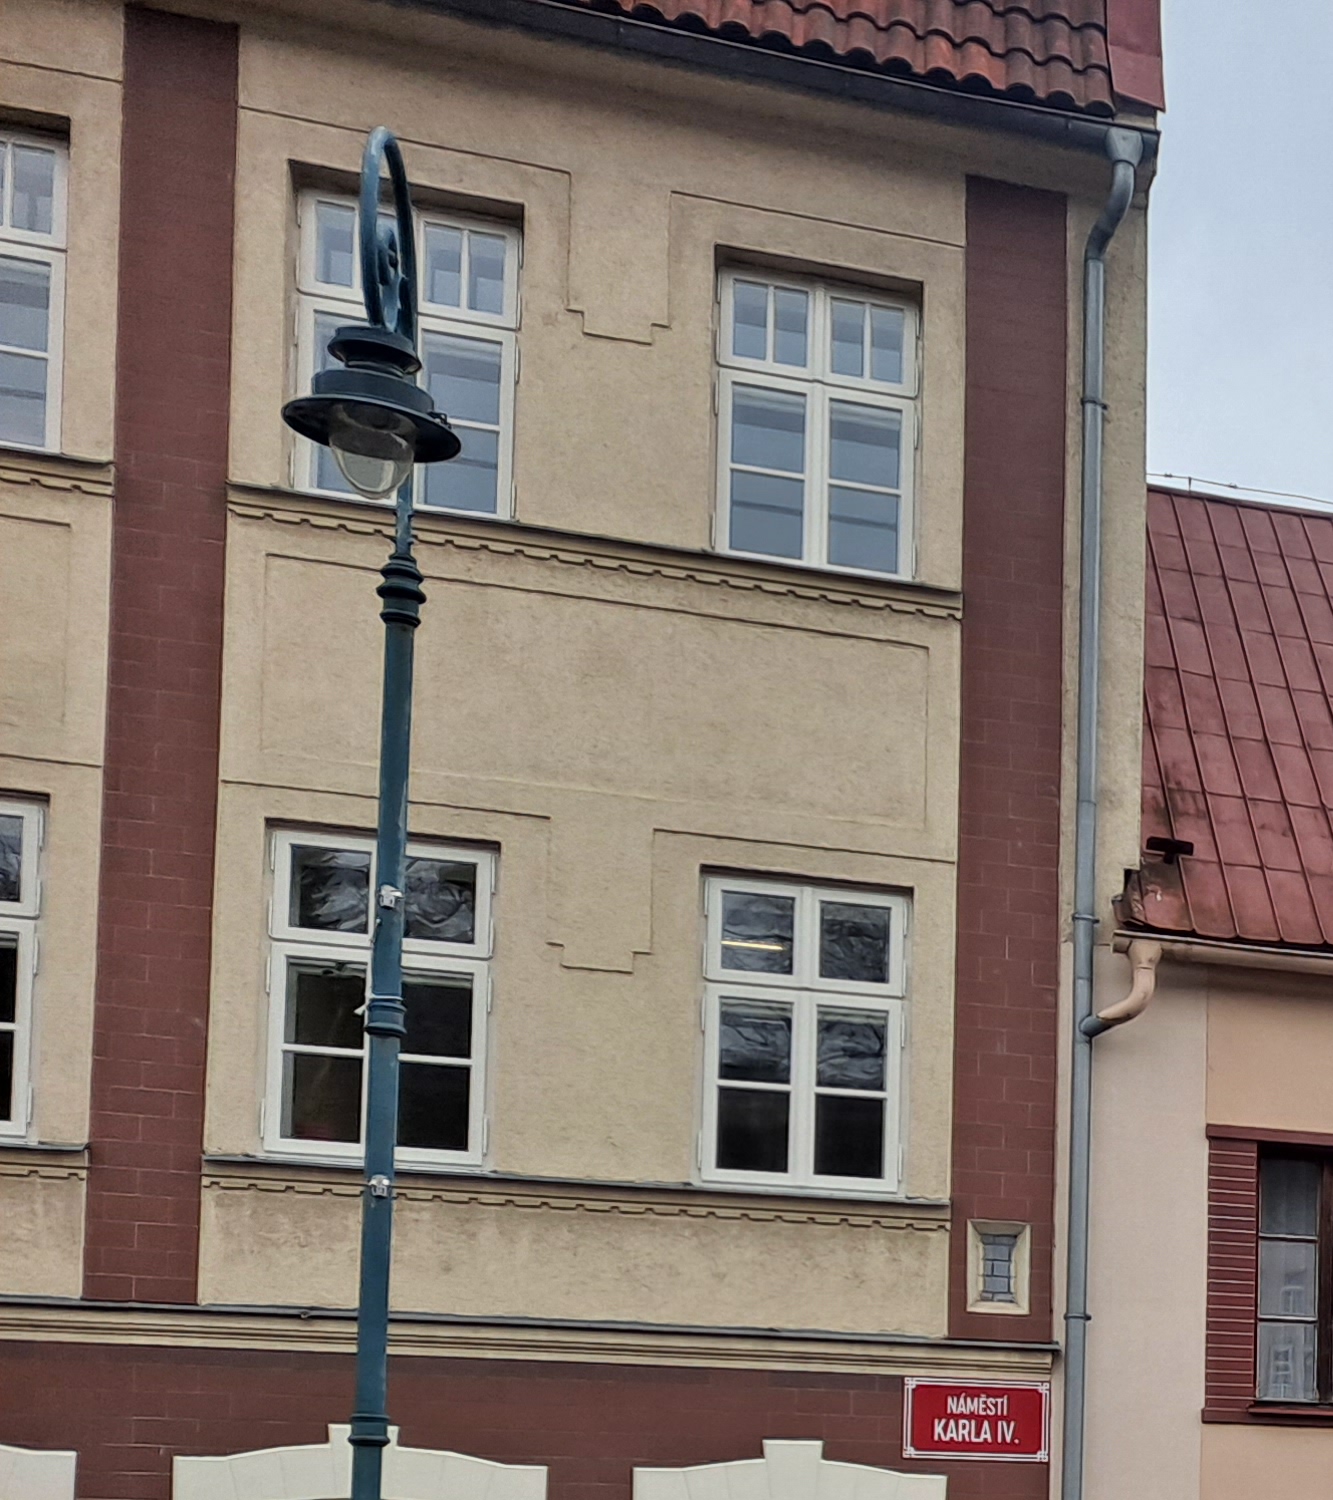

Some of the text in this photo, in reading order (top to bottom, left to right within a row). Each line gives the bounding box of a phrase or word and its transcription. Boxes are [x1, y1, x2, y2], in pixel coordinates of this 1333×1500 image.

[946, 1392, 1009, 1417] NÁMĚSTÍ
[933, 1418, 1020, 1444] KARLA IV.
